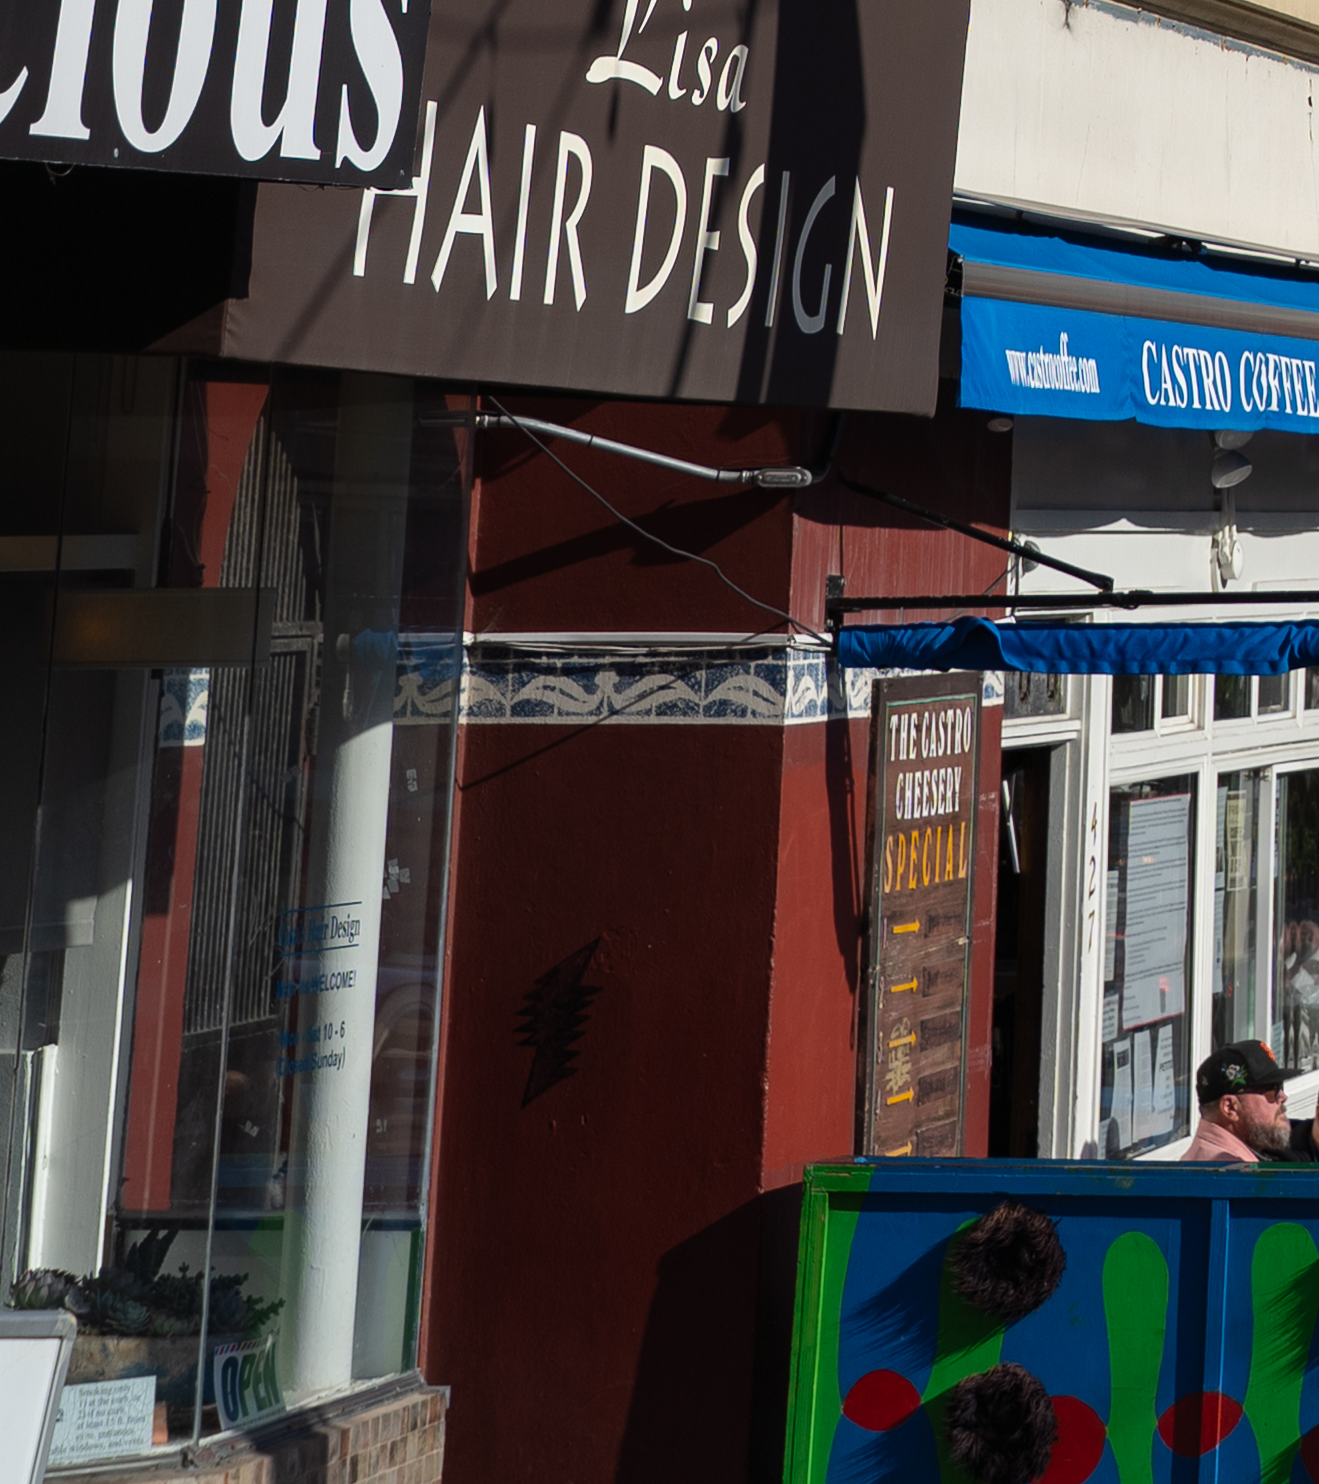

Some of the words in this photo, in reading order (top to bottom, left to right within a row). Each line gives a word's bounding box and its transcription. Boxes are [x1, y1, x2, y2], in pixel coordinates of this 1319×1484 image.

[352, 100, 588, 312] HAIR
[624, 144, 894, 341] DESIGN
[1141, 339, 1231, 413] CASTRO
[889, 709, 918, 762] THE
[921, 706, 972, 759] CASTRO
[895, 766, 962, 821] CHEESERY
[884, 821, 968, 894] SPECIAL
[330, 914, 360, 944] Design
[312, 1046, 346, 1070] Sunday)
[324, 1022, 333, 1041] 10
[340, 1020, 346, 1038] 6
[221, 1343, 281, 1423] OPEN
